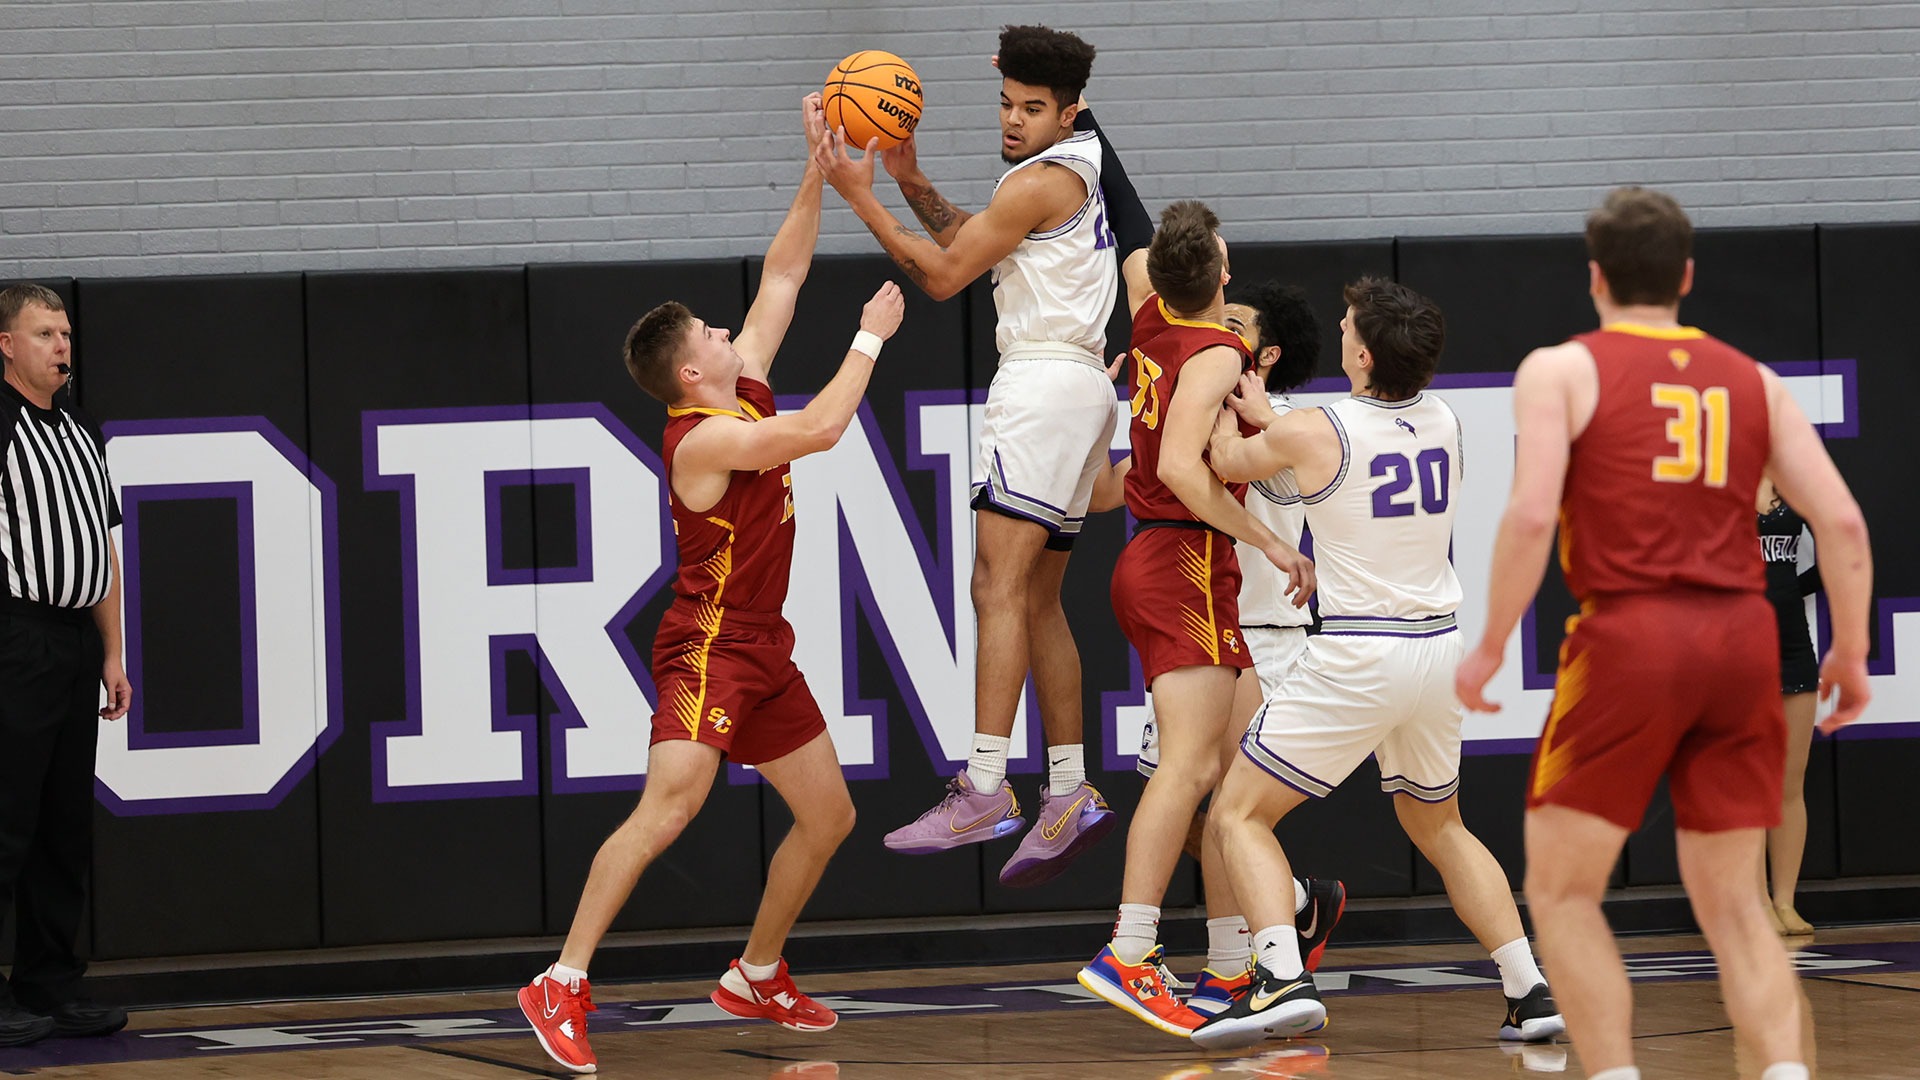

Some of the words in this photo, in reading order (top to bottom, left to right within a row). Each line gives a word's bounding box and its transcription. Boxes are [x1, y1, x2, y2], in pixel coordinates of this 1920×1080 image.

[1368, 446, 1450, 519] 20
[1650, 382, 1730, 489] 31
[95, 358, 1920, 815] ORNL
